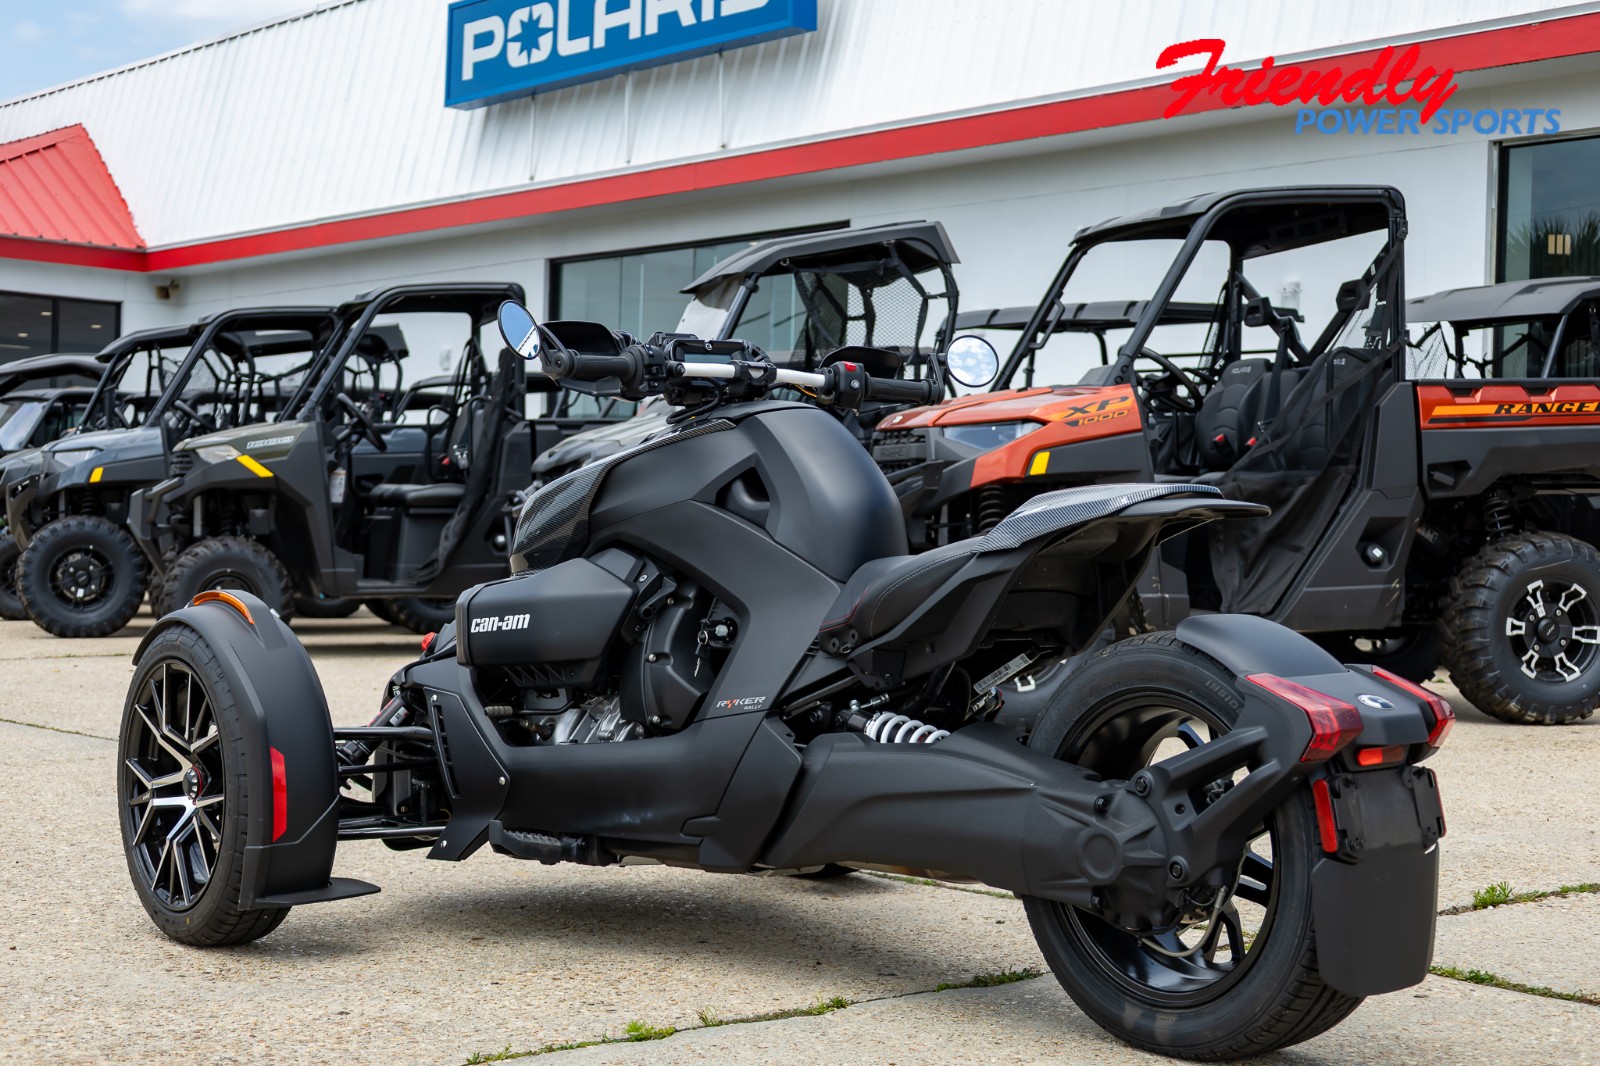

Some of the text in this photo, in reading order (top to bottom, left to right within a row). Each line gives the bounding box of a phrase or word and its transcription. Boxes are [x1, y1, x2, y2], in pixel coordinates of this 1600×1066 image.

[461, 0, 772, 81] POLAR
[1062, 396, 1130, 419] XP
[1077, 409, 1129, 426] 1000
[1493, 401, 1600, 415] RANGE
[470, 613, 531, 633] can-am
[716, 696, 767, 709] RYKER
[1205, 680, 1241, 714] INSID
